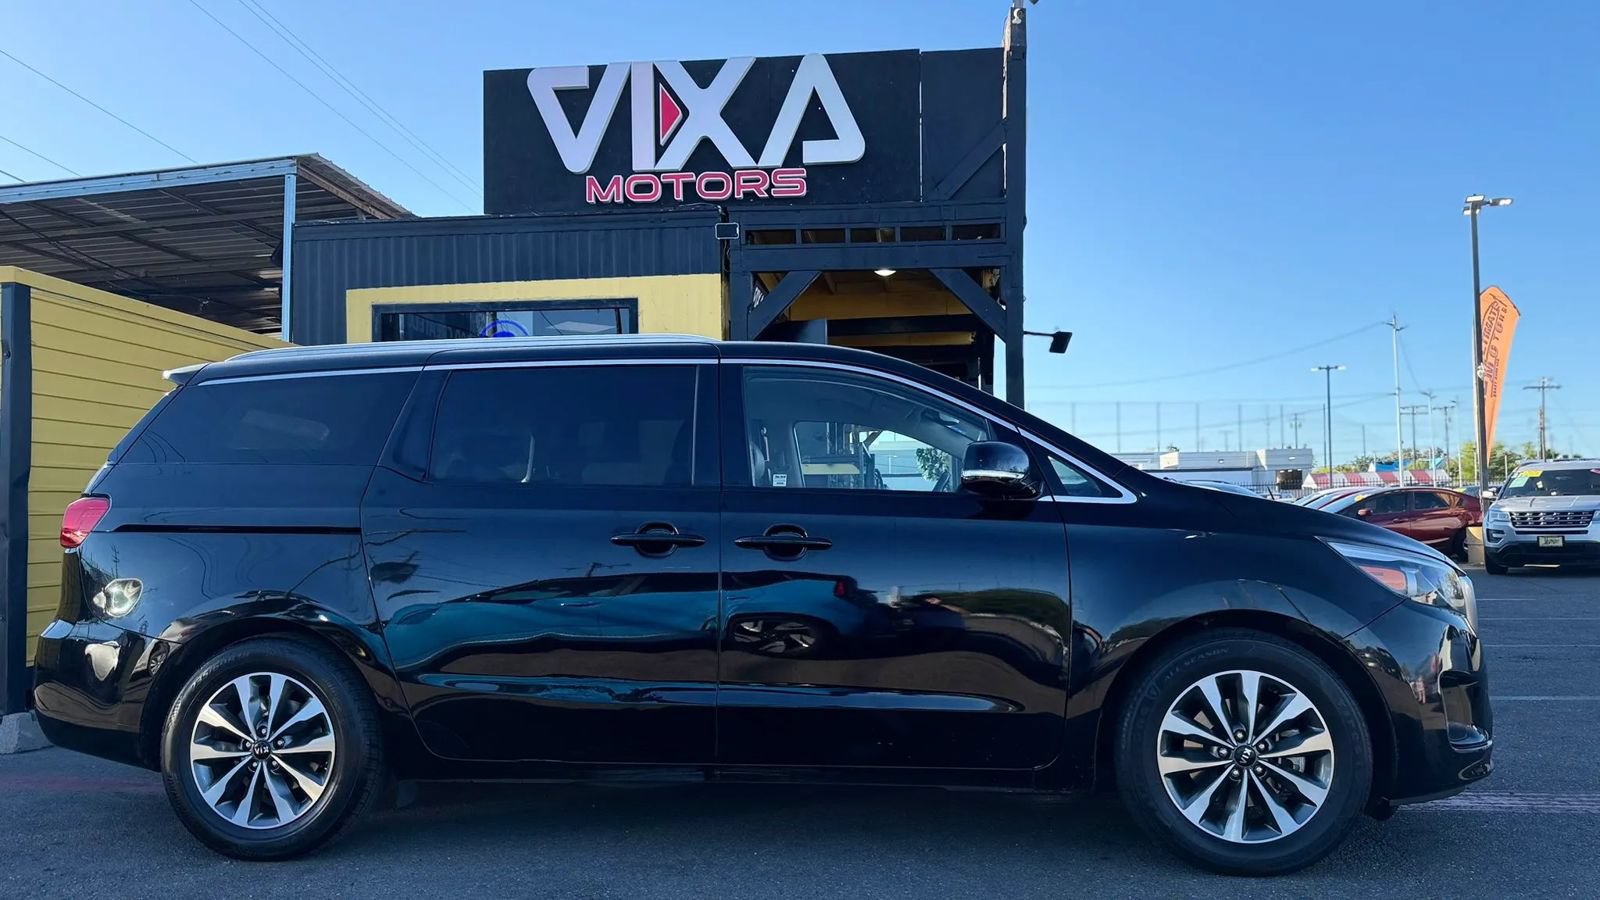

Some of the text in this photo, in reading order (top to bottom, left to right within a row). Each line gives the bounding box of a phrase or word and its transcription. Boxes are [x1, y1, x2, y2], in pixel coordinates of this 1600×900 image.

[527, 53, 865, 174] VIXA
[585, 167, 808, 204] MOTORS
[1239, 748, 1251, 763] KIA
